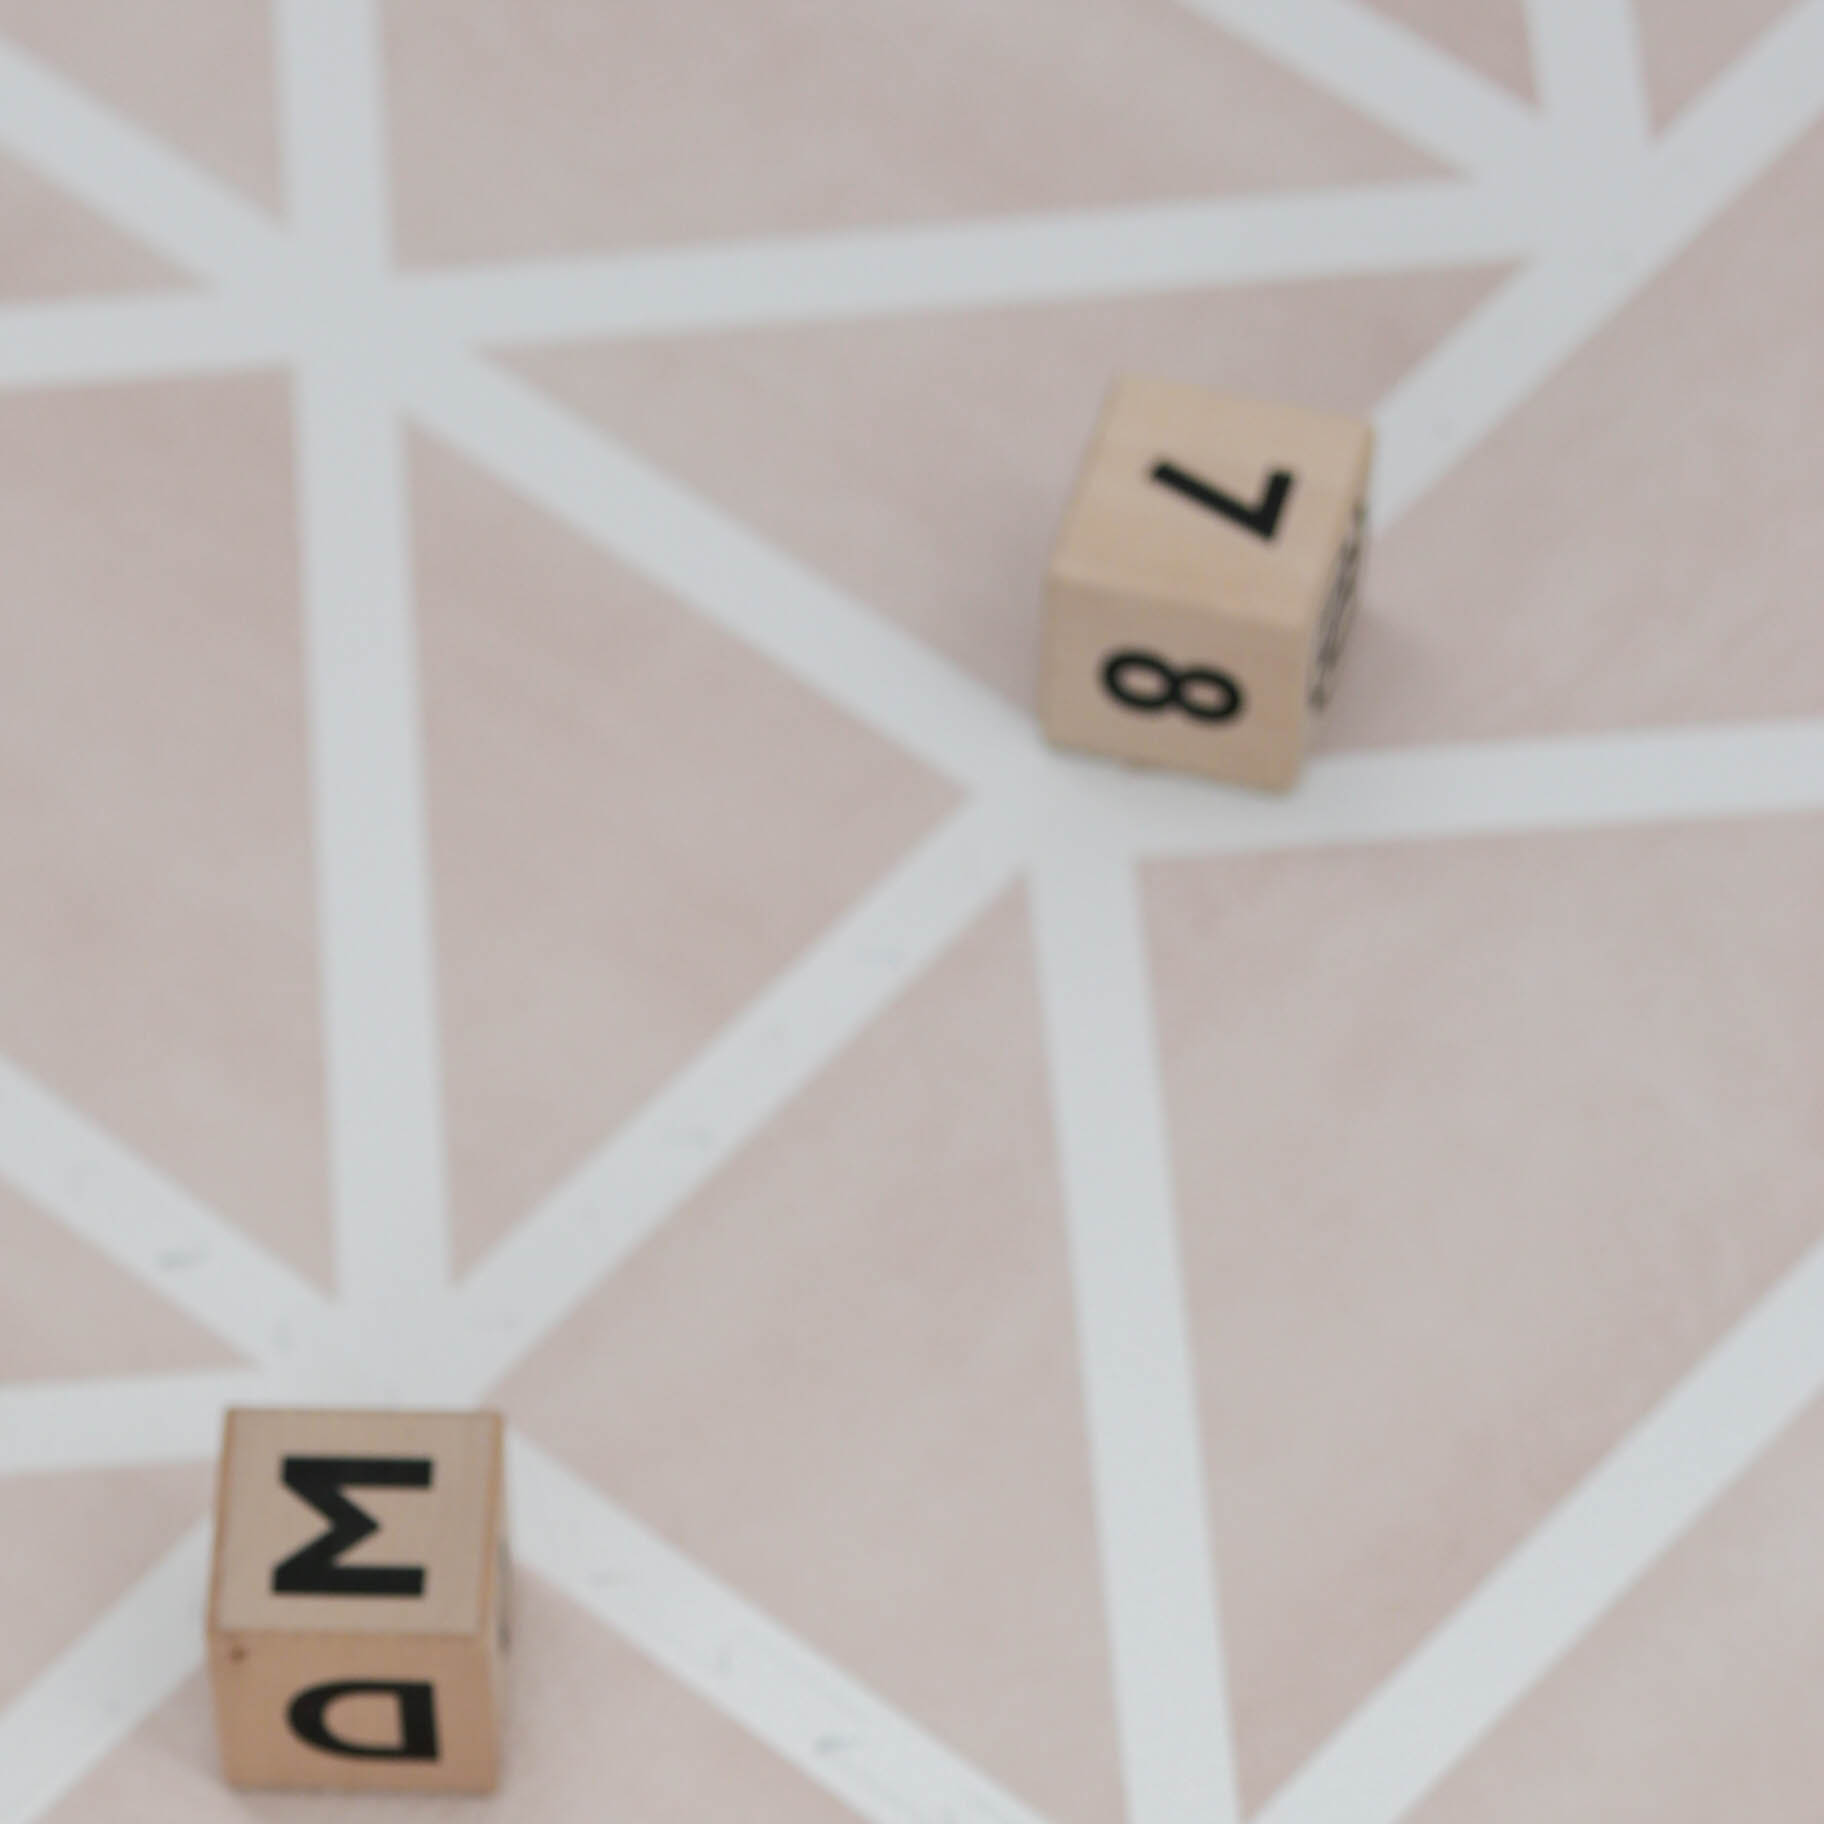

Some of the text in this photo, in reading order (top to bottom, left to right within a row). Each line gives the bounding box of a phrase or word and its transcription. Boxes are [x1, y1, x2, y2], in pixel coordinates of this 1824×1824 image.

[1151, 462, 1293, 541] 7
[1102, 651, 1243, 724] 8
[272, 1456, 433, 1598] M
[287, 1680, 439, 1762] D
